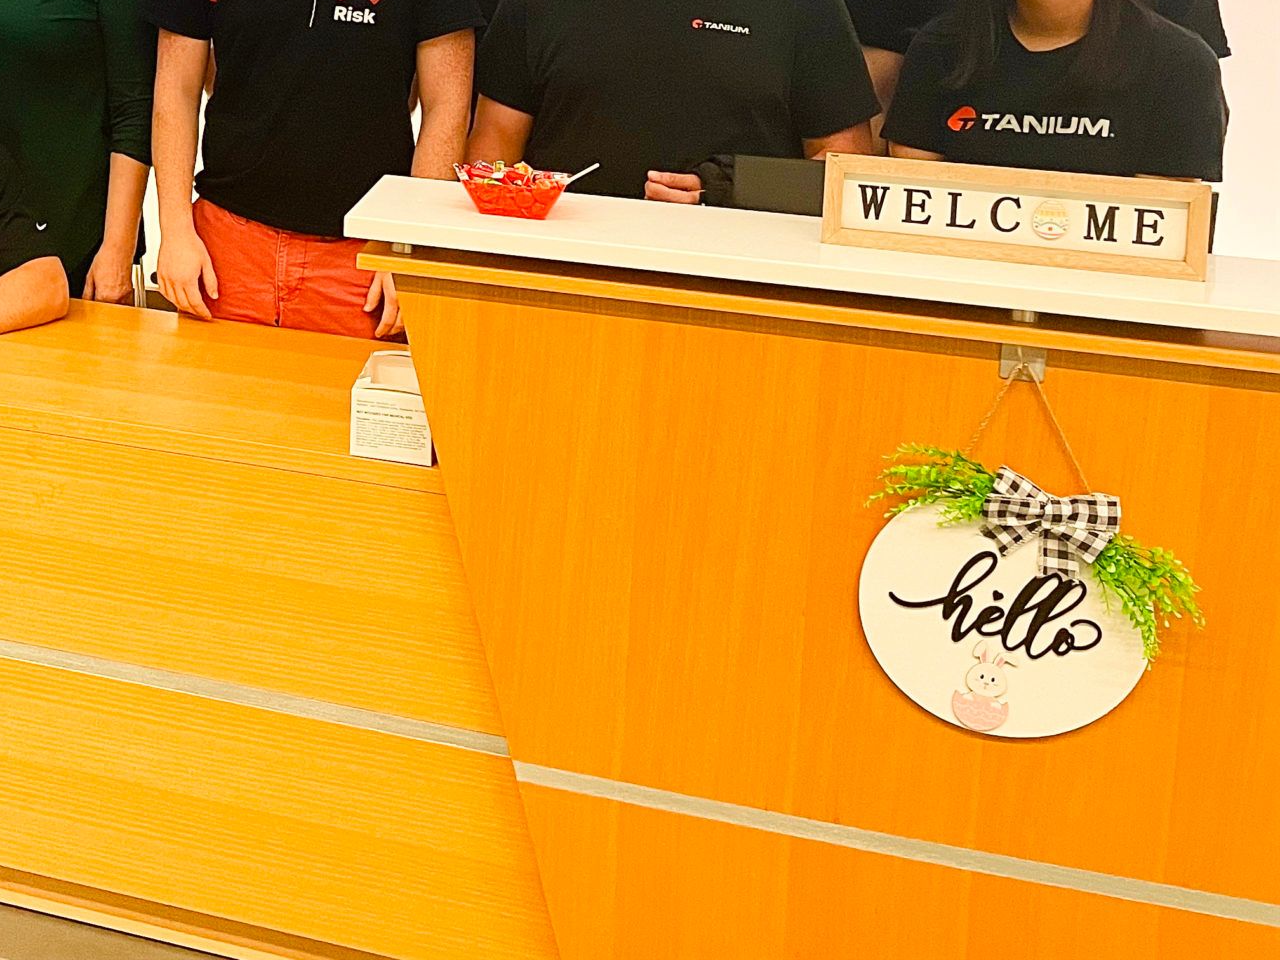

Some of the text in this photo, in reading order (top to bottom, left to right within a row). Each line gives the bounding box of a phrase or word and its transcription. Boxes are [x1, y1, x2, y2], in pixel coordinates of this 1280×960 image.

[333, 5, 376, 25] Risk
[703, 21, 750, 35] TANIUM
[888, 550, 1103, 660] hello
